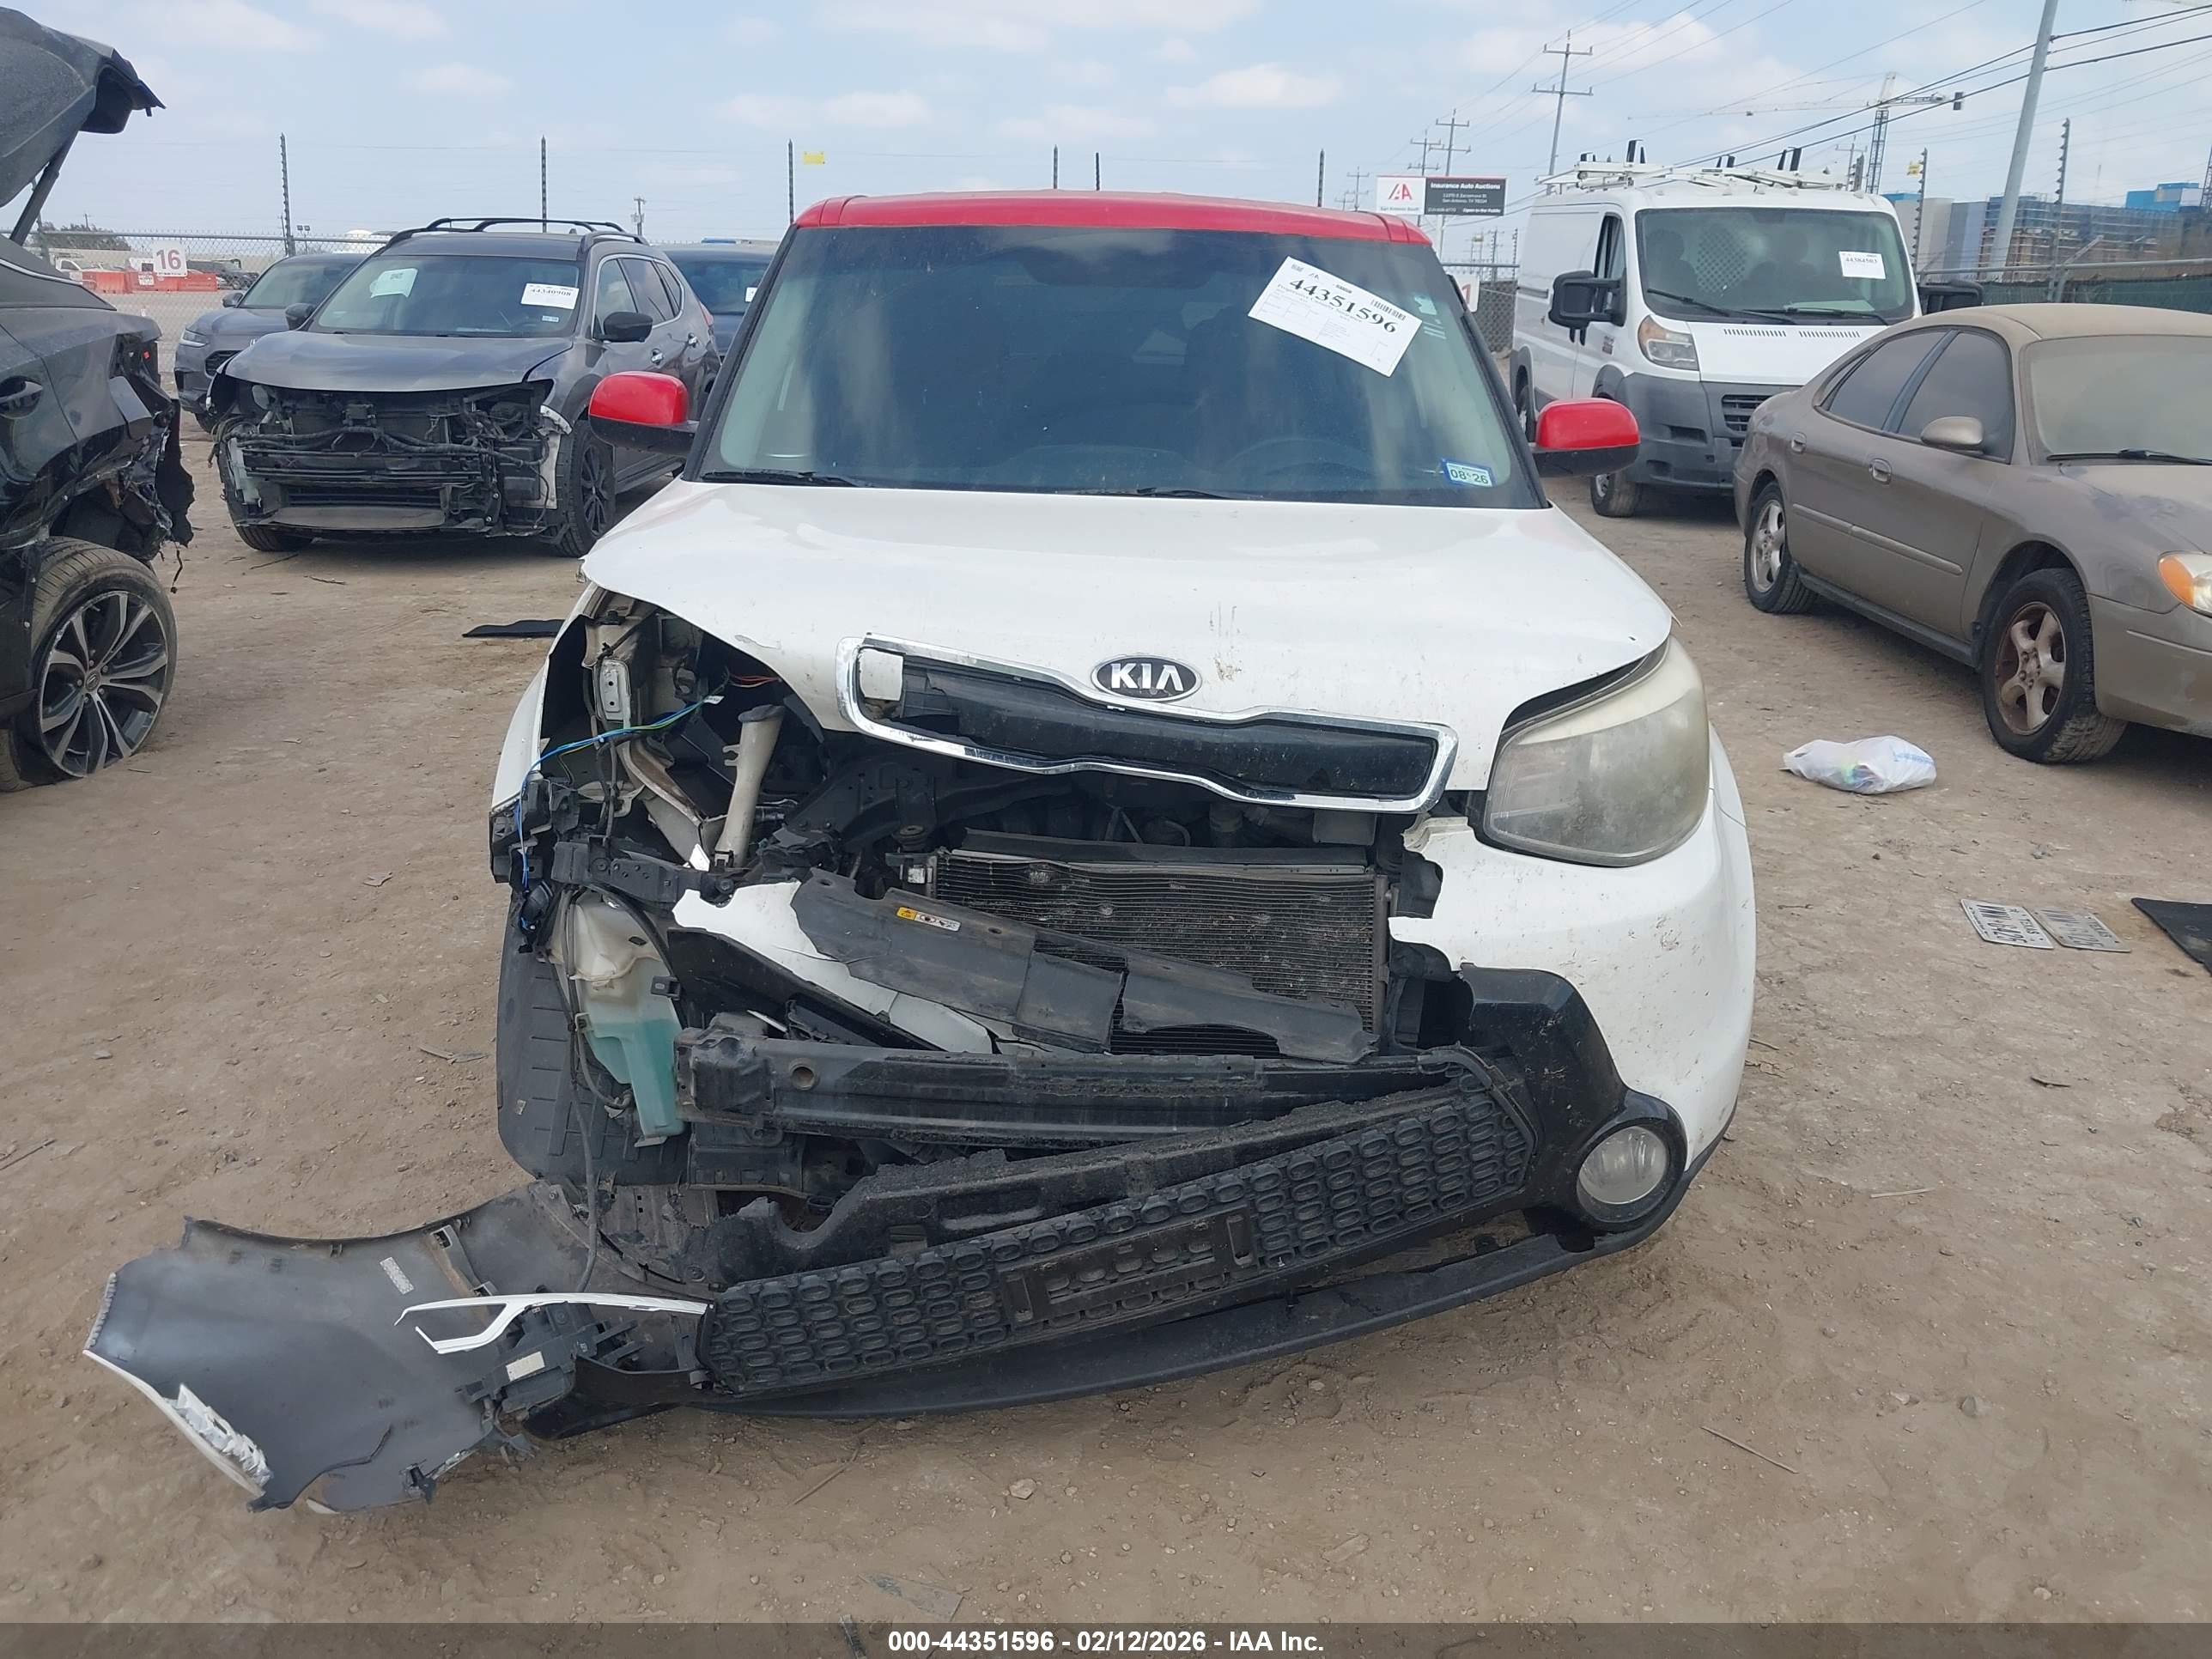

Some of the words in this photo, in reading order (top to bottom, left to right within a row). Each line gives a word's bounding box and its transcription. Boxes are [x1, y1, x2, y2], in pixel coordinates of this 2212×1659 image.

[155, 249, 182, 270] 16
[1289, 278, 1398, 333] 44351596
[1450, 469, 1467, 480] 08
[1472, 473, 1489, 484] 26
[1110, 663, 1184, 691] KIA
[2019, 917, 2040, 935] TEXAS
